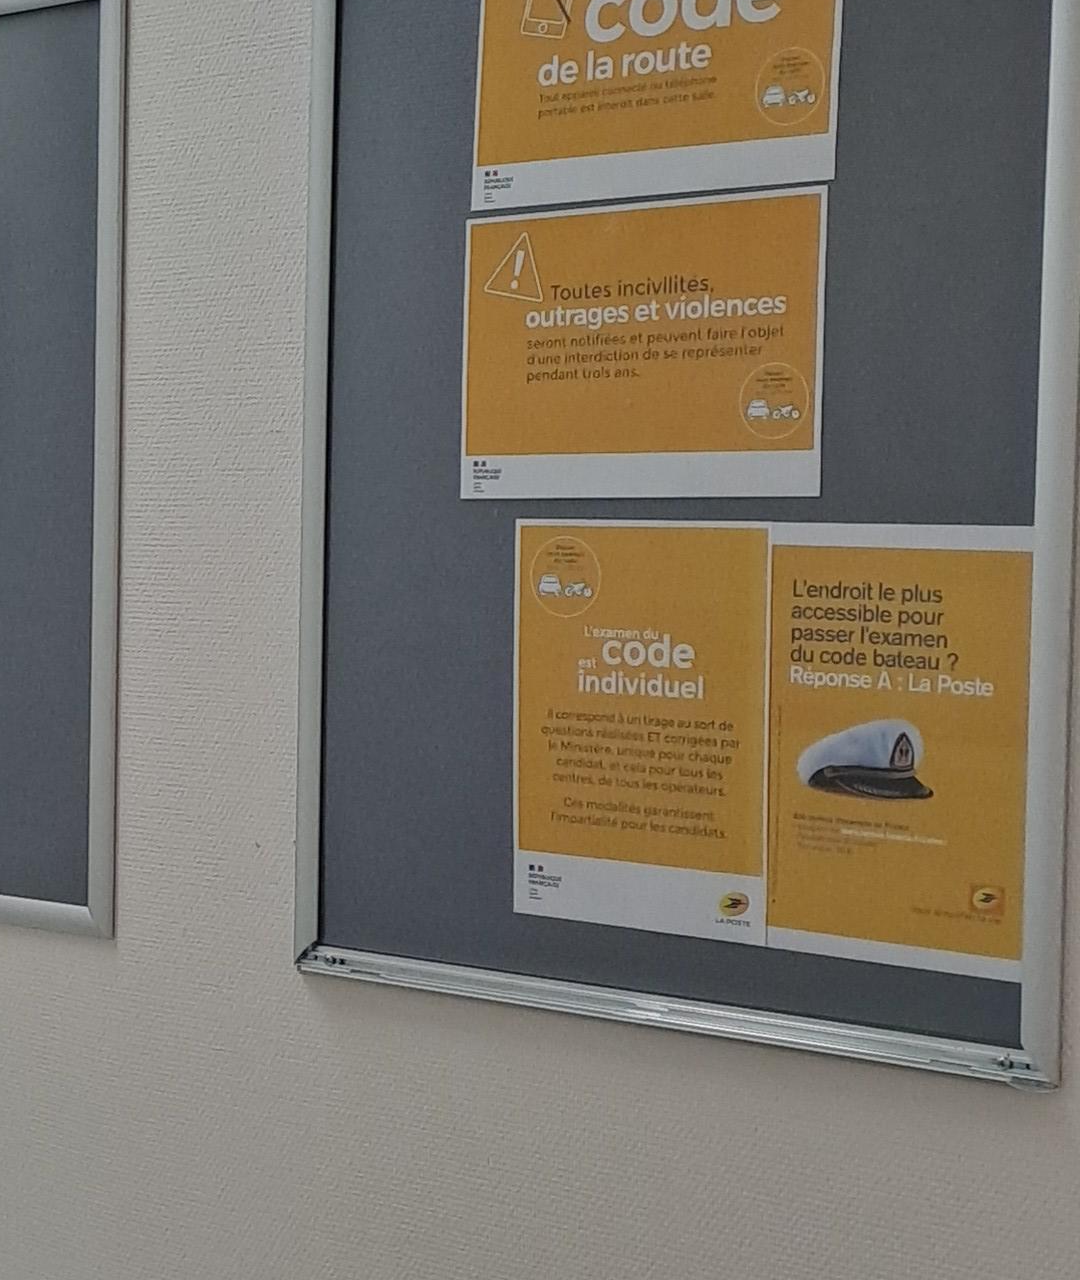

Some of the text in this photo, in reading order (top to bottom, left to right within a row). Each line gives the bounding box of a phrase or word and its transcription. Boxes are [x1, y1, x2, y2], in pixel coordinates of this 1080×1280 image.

[537, 40, 713, 87] de la route
[550, 275, 714, 301] Toutes incivilités,
[526, 295, 787, 330] outrages et violences
[527, 324, 785, 350] seront notifiées et peuvent faire l'objet
[527, 344, 763, 365] d'une interdiction de se représenter
[526, 366, 640, 384] pendant trois ans.
[793, 579, 943, 605] L'endroit le plus
[791, 604, 944, 628] accessible pour
[584, 625, 660, 640] L'examen du
[791, 625, 948, 649] passer l'examen
[578, 633, 696, 669] est code
[790, 643, 959, 671] du code bateau ?
[578, 669, 705, 699] individuel
[790, 665, 872, 689] Réponse
[896, 675, 903, 691] :
[908, 672, 931, 693] La
[937, 674, 994, 697] Poste
[627, 715, 641, 725] un
[677, 720, 691, 729] au
[694, 719, 716, 730] sort
[720, 720, 734, 732] de
[647, 731, 661, 742] ET
[664, 733, 718, 749] corrigées
[721, 738, 740, 750] par
[658, 750, 685, 763] pour
[688, 751, 732, 766] chaque
[598, 775, 613, 786] de
[616, 777, 640, 789] tous
[642, 778, 658, 791] les
[649, 766, 676, 778] pour
[679, 766, 704, 778] tous
[707, 768, 723, 780] les
[620, 819, 648, 832] pour
[649, 821, 666, 833] les
